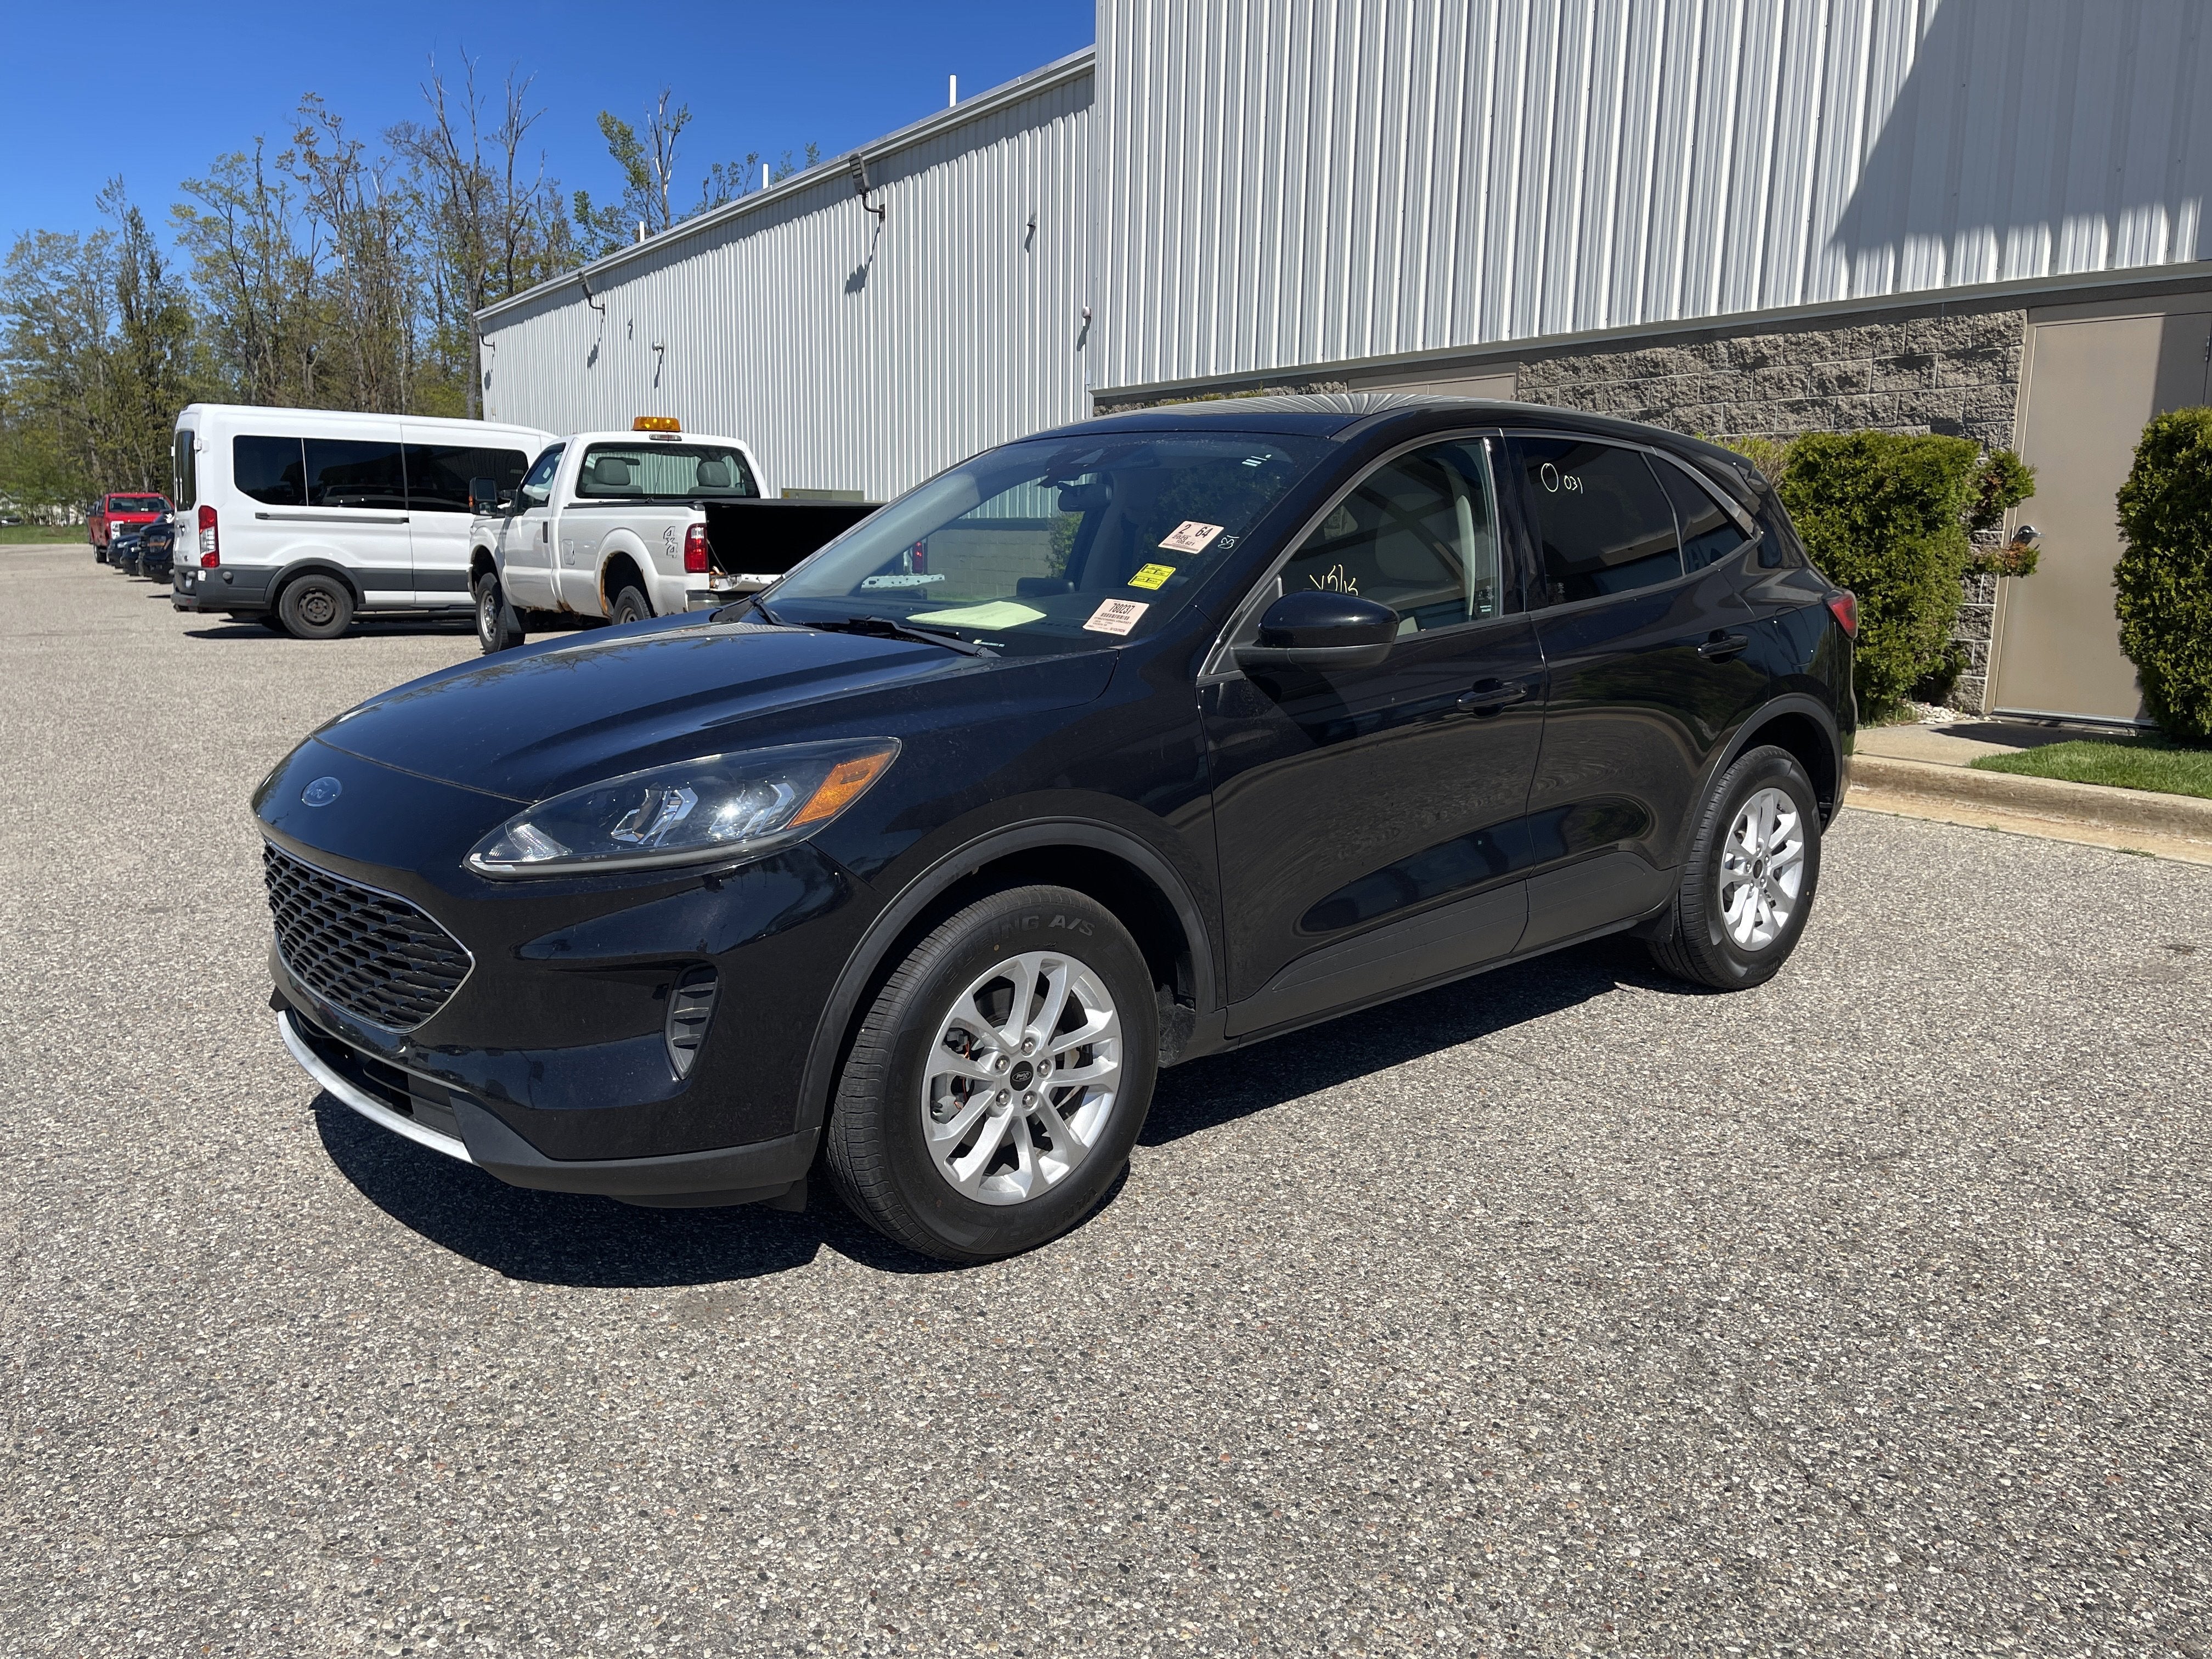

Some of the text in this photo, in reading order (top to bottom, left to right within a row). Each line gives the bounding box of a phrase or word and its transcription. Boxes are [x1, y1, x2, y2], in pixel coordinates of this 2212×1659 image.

[1178, 524, 1192, 534] 2
[1195, 527, 1213, 538] 64
[1109, 603, 1136, 615] 780237
[1048, 914, 1096, 936] A/S
